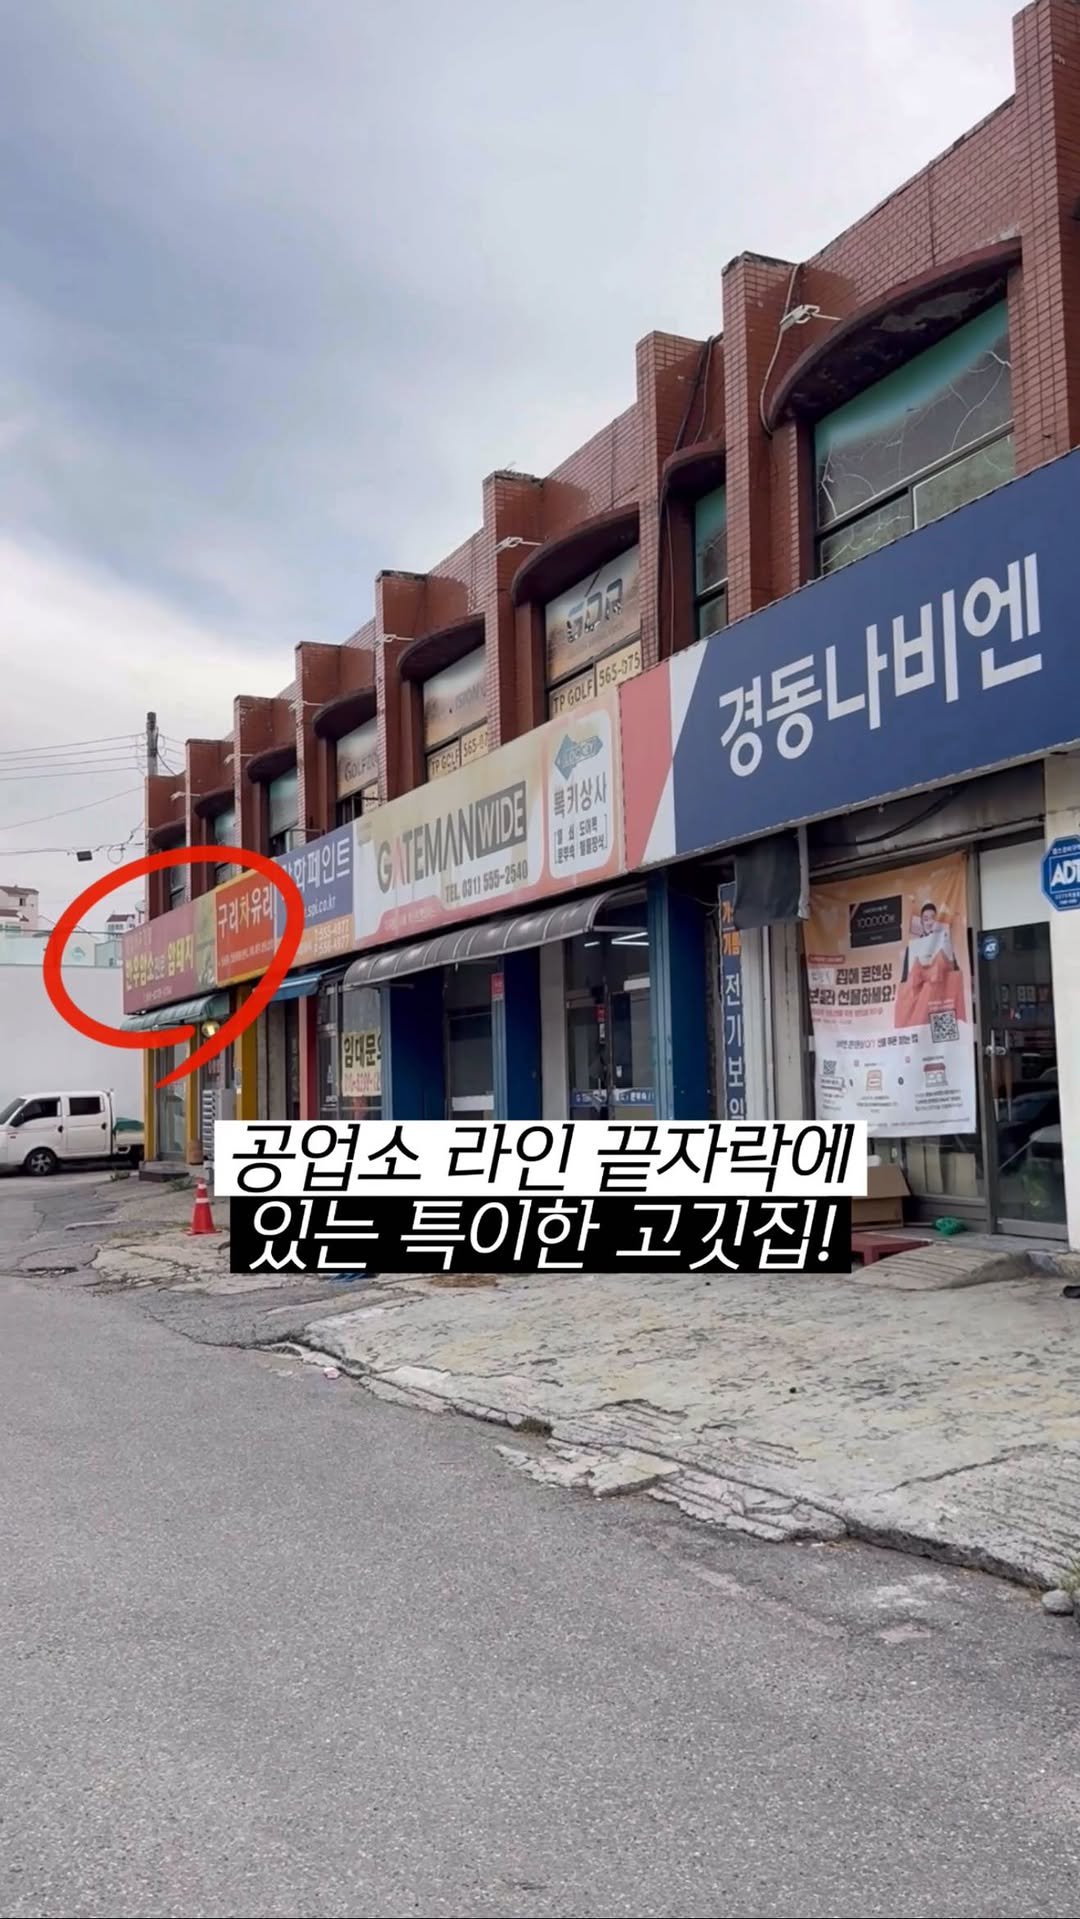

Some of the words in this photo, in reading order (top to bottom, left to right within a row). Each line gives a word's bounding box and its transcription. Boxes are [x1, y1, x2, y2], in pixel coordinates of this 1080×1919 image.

[719, 552, 1043, 777] 경동나비엔
[553, 694, 566, 714] TP
[567, 680, 593, 709] GOLF
[431, 758, 440, 776] TP
[441, 749, 460, 770] GOLF
[554, 771, 607, 819] 록키상사
[476, 783, 526, 854] WIDE
[483, 859, 528, 891] 555-2540
[1050, 858, 1080, 887] ADT
[218, 881, 273, 940] 구리차유리
[304, 894, 336, 918] .spi.co.kr
[861, 963, 893, 984] 콘덴싱
[838, 983, 897, 1006] 선물하세요!
